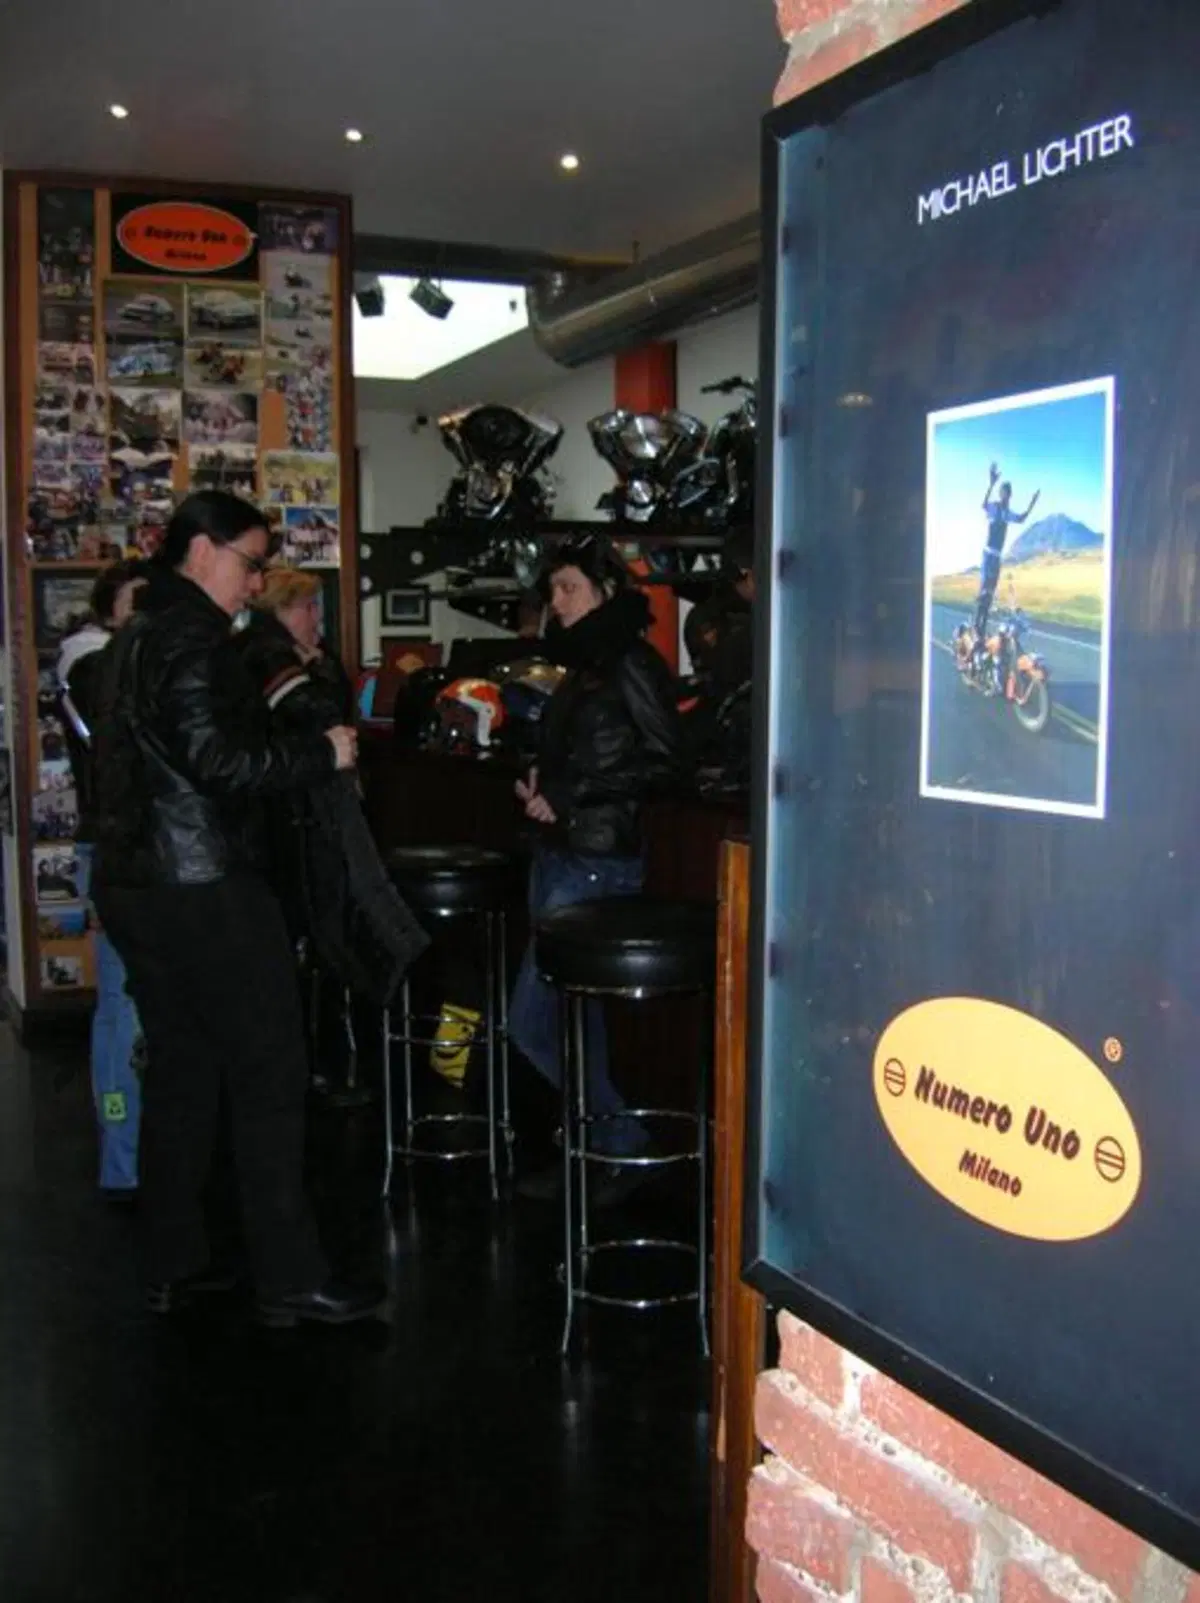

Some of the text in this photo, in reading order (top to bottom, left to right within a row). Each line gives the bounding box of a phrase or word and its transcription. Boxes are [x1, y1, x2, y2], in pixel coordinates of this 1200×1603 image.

[917, 113, 1134, 225] MICHAEL LICHTER
[914, 1065, 1081, 1161] Numero Uno
[958, 1149, 1023, 1198] Milano
